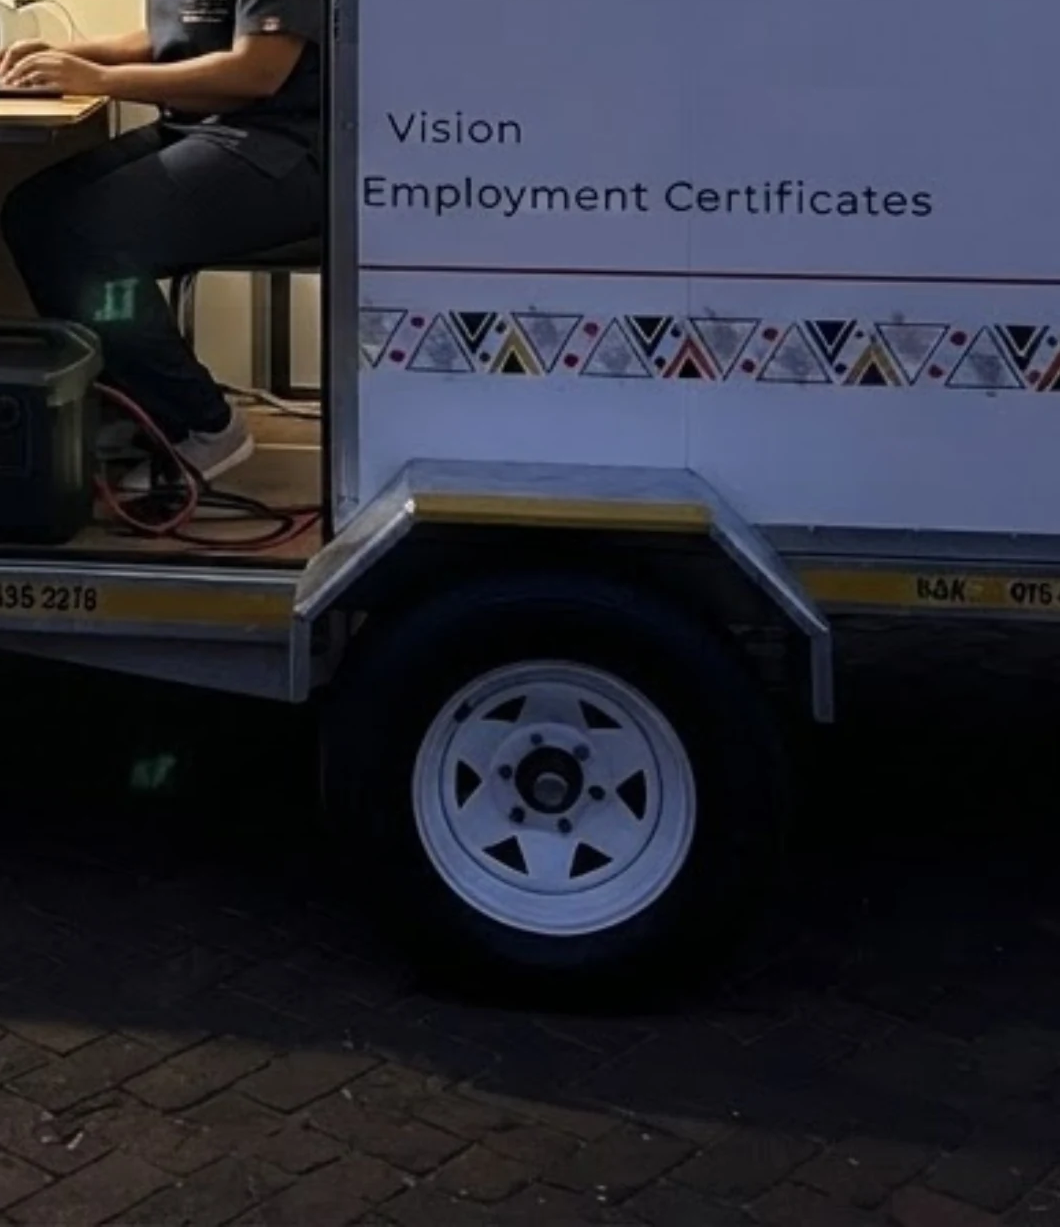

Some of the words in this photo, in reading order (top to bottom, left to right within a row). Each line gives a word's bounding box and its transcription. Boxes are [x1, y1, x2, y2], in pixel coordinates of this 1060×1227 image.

[386, 111, 522, 144] Vision
[363, 176, 649, 217] Employment
[665, 179, 933, 217] Certificates
